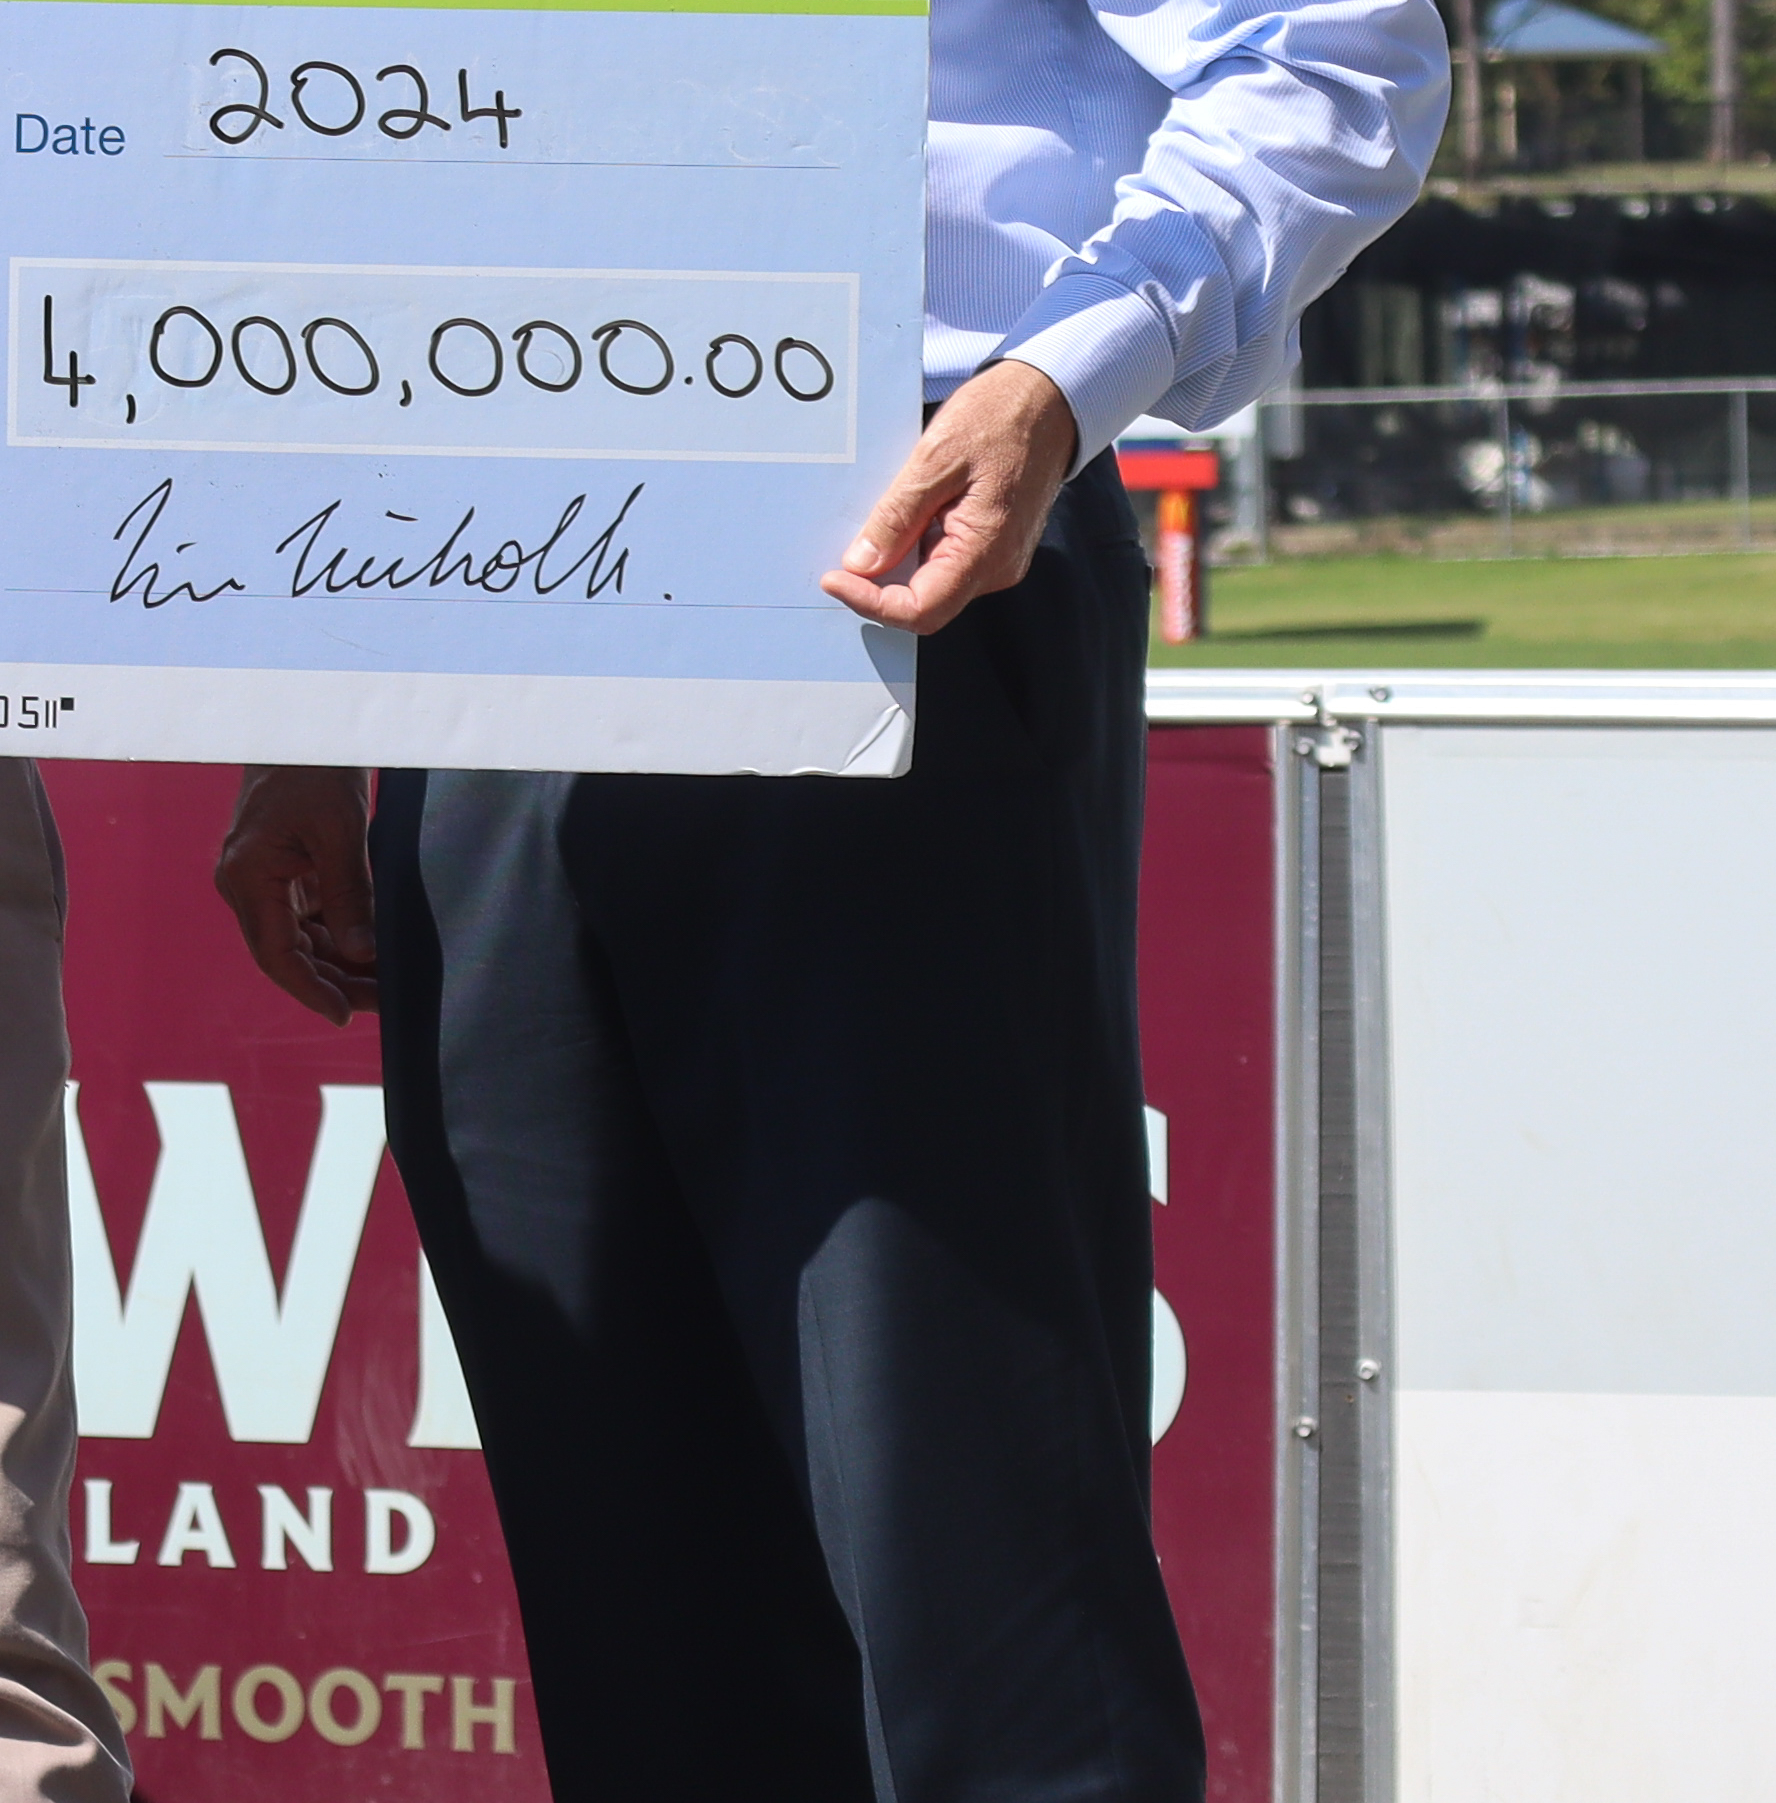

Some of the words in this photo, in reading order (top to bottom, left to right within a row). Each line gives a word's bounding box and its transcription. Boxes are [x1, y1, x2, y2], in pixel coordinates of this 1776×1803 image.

[14, 113, 127, 156] Date
[208, 48, 522, 149] 2024
[44, 294, 834, 426] 4,000,000.00
[90, 1658, 516, 1754] SMOOTH
